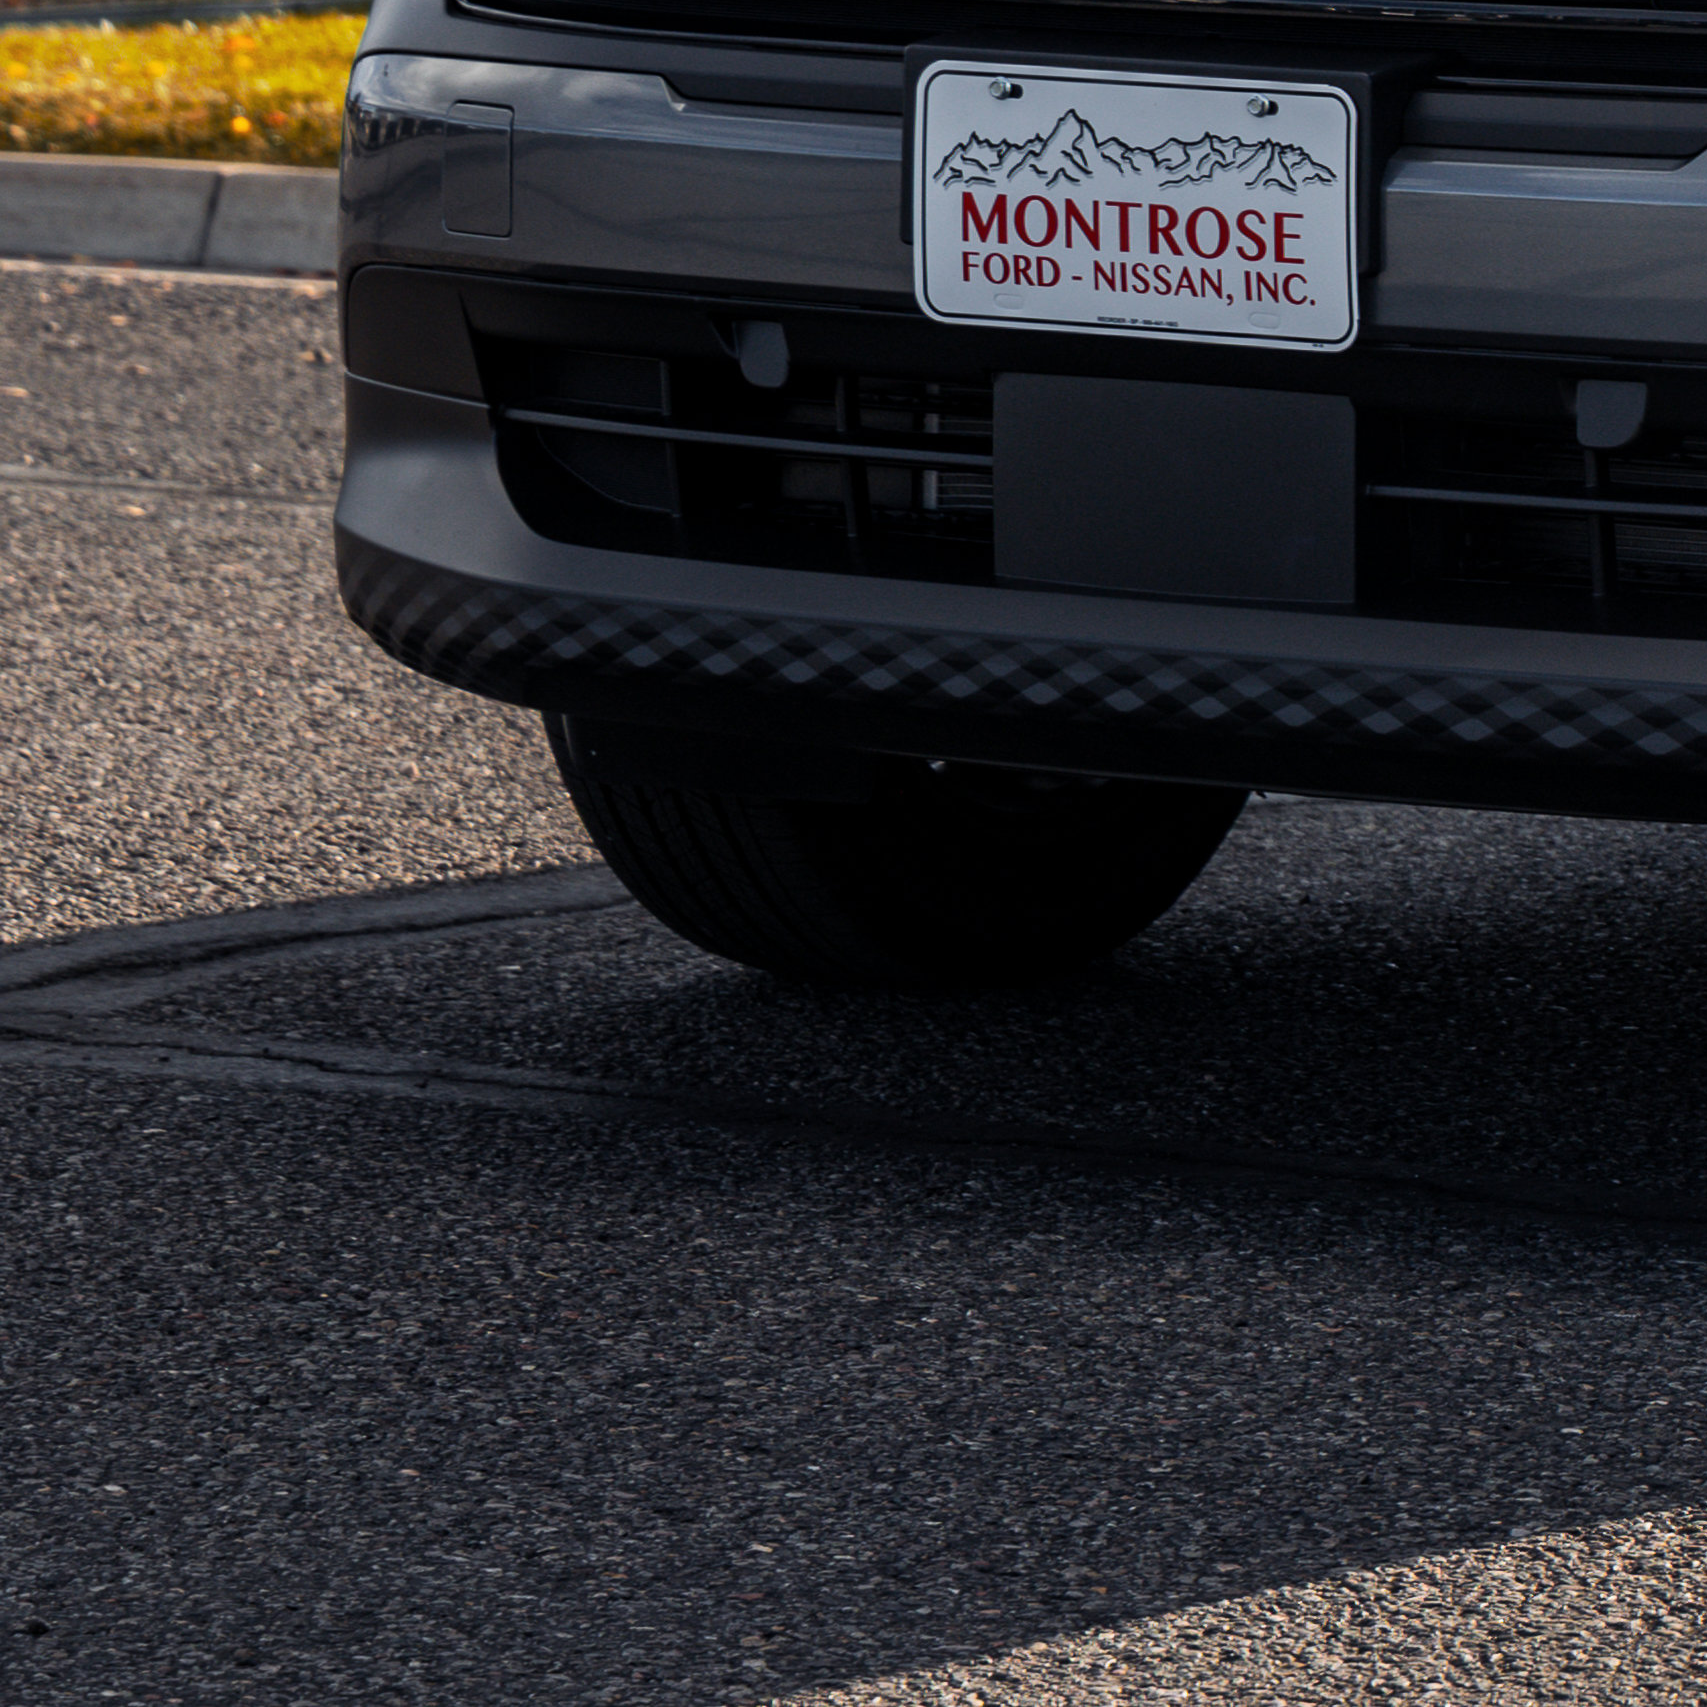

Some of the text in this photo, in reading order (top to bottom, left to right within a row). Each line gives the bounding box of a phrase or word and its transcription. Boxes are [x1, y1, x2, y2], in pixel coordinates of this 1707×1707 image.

[961, 191, 1306, 265] MONTROSE
[961, 250, 1061, 288] FORD
[1093, 259, 1236, 307] NISSAN,
[1244, 269, 1317, 307] INC.
